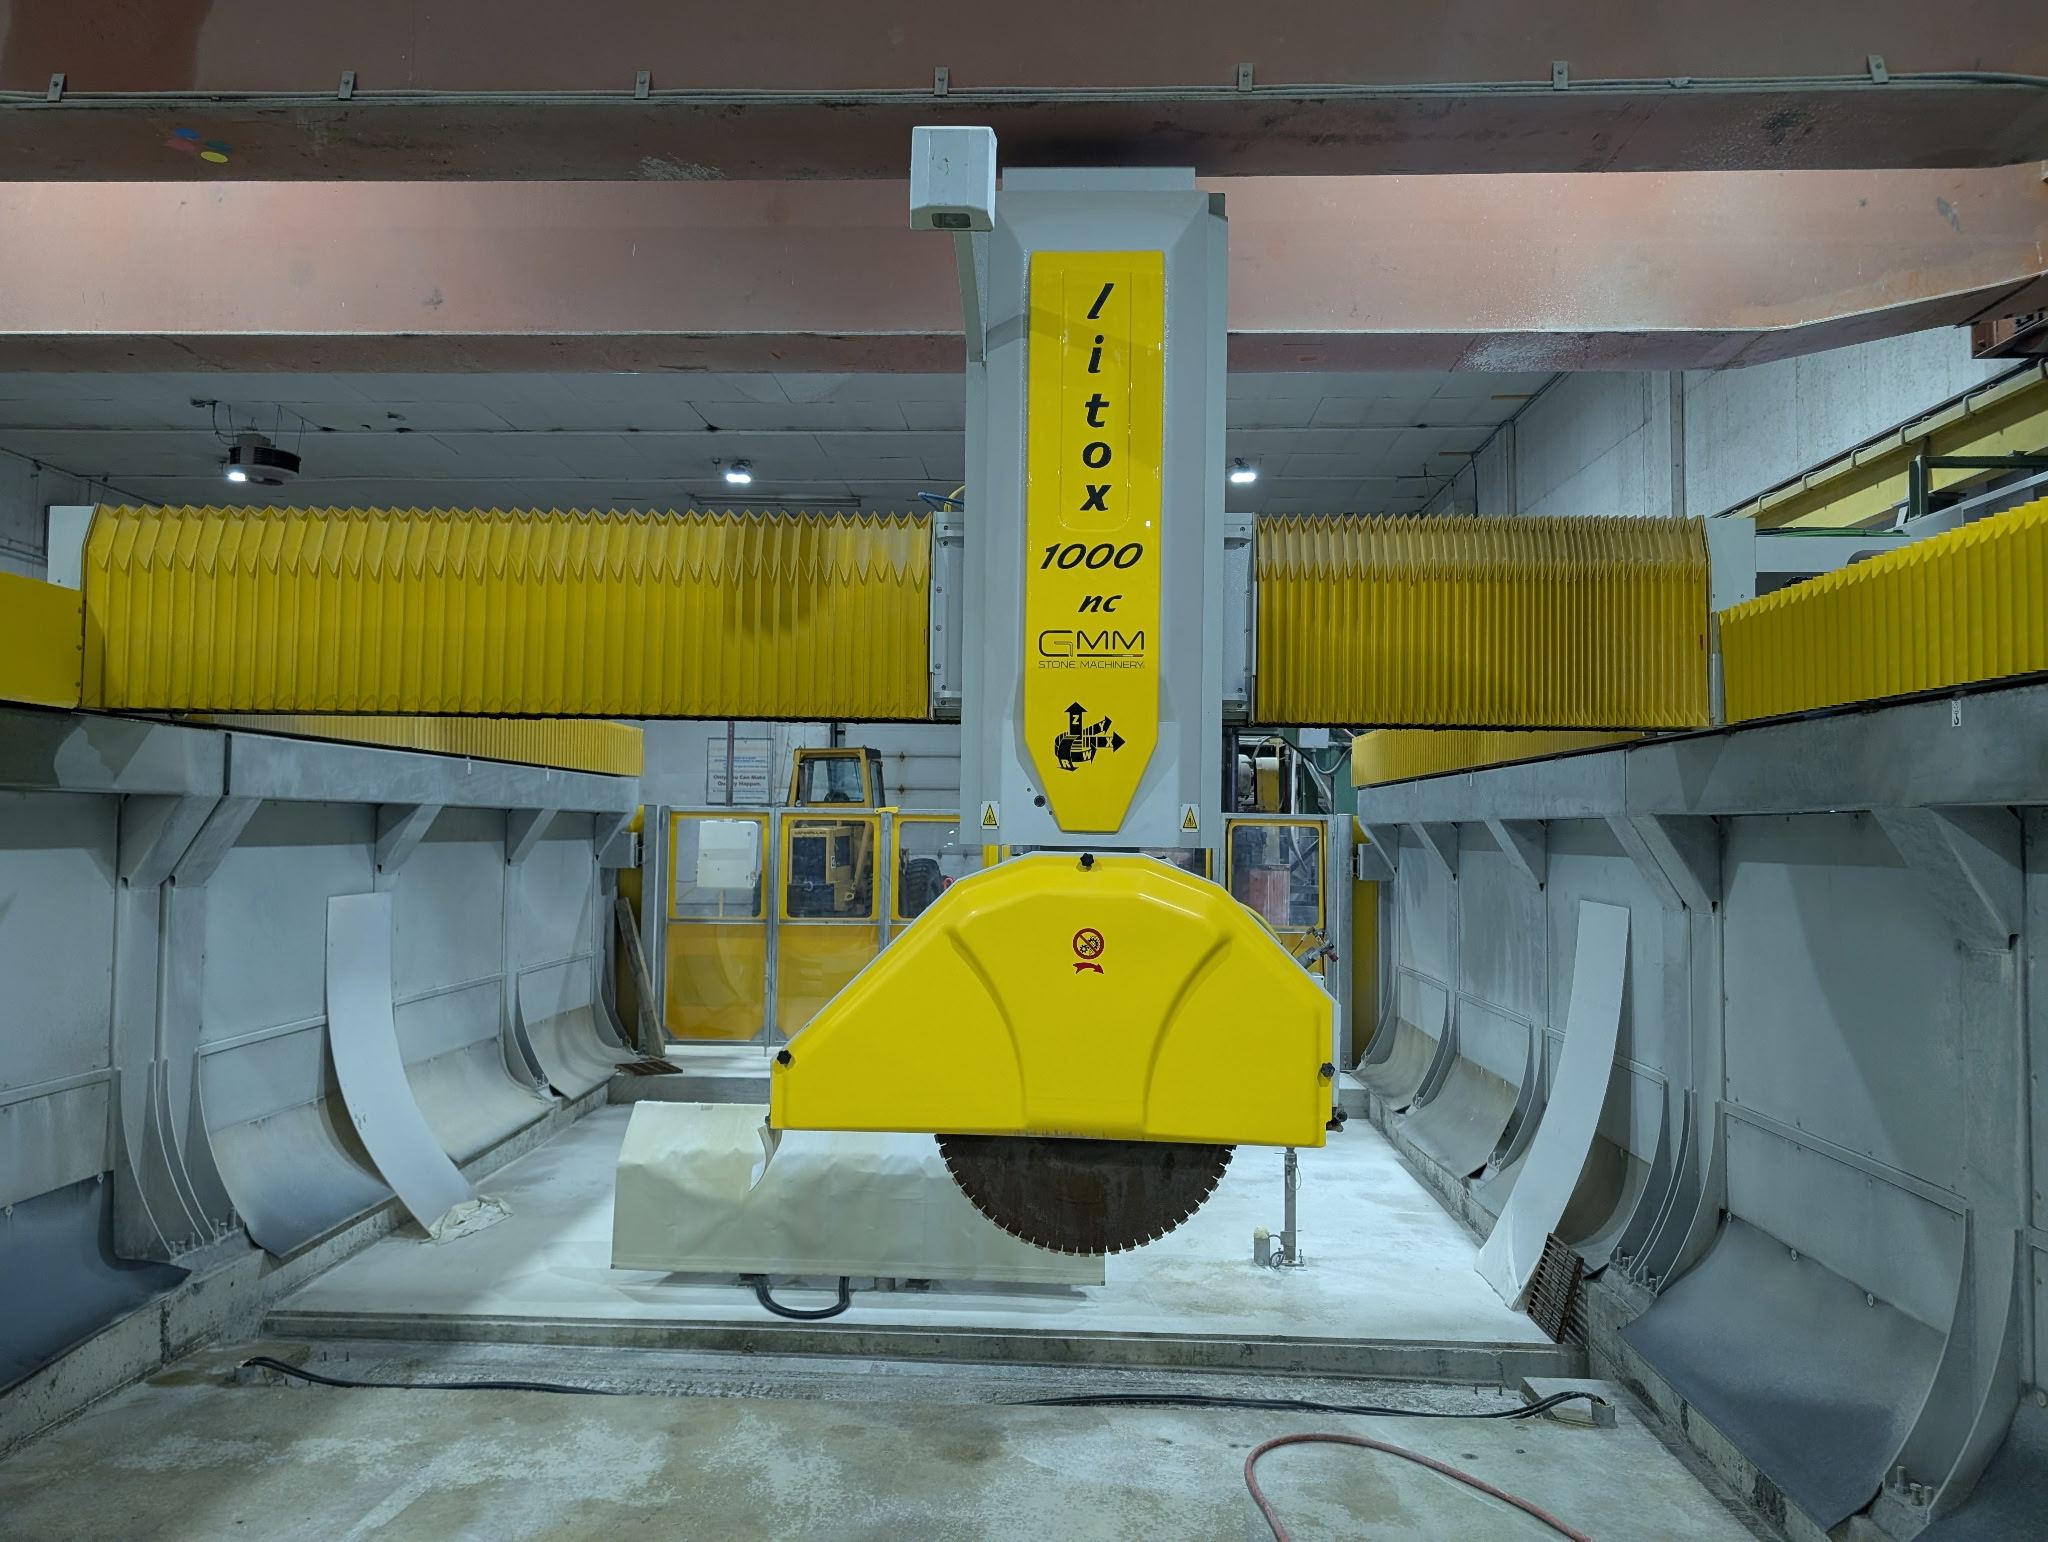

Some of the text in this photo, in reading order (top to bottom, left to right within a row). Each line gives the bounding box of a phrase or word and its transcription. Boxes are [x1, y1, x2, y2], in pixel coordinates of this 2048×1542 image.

[1080, 283, 1114, 512] litox
[1040, 543, 1144, 569] 1000
[1078, 595, 1123, 613] nc
[1039, 630, 1145, 657] GMM
[1039, 661, 1144, 669] STONE MACHINERY
[1072, 715, 1079, 724] Z
[1099, 721, 1106, 731] Y
[1106, 737, 1113, 747] X
[1083, 750, 1092, 760] W
[1061, 759, 1071, 769] R
